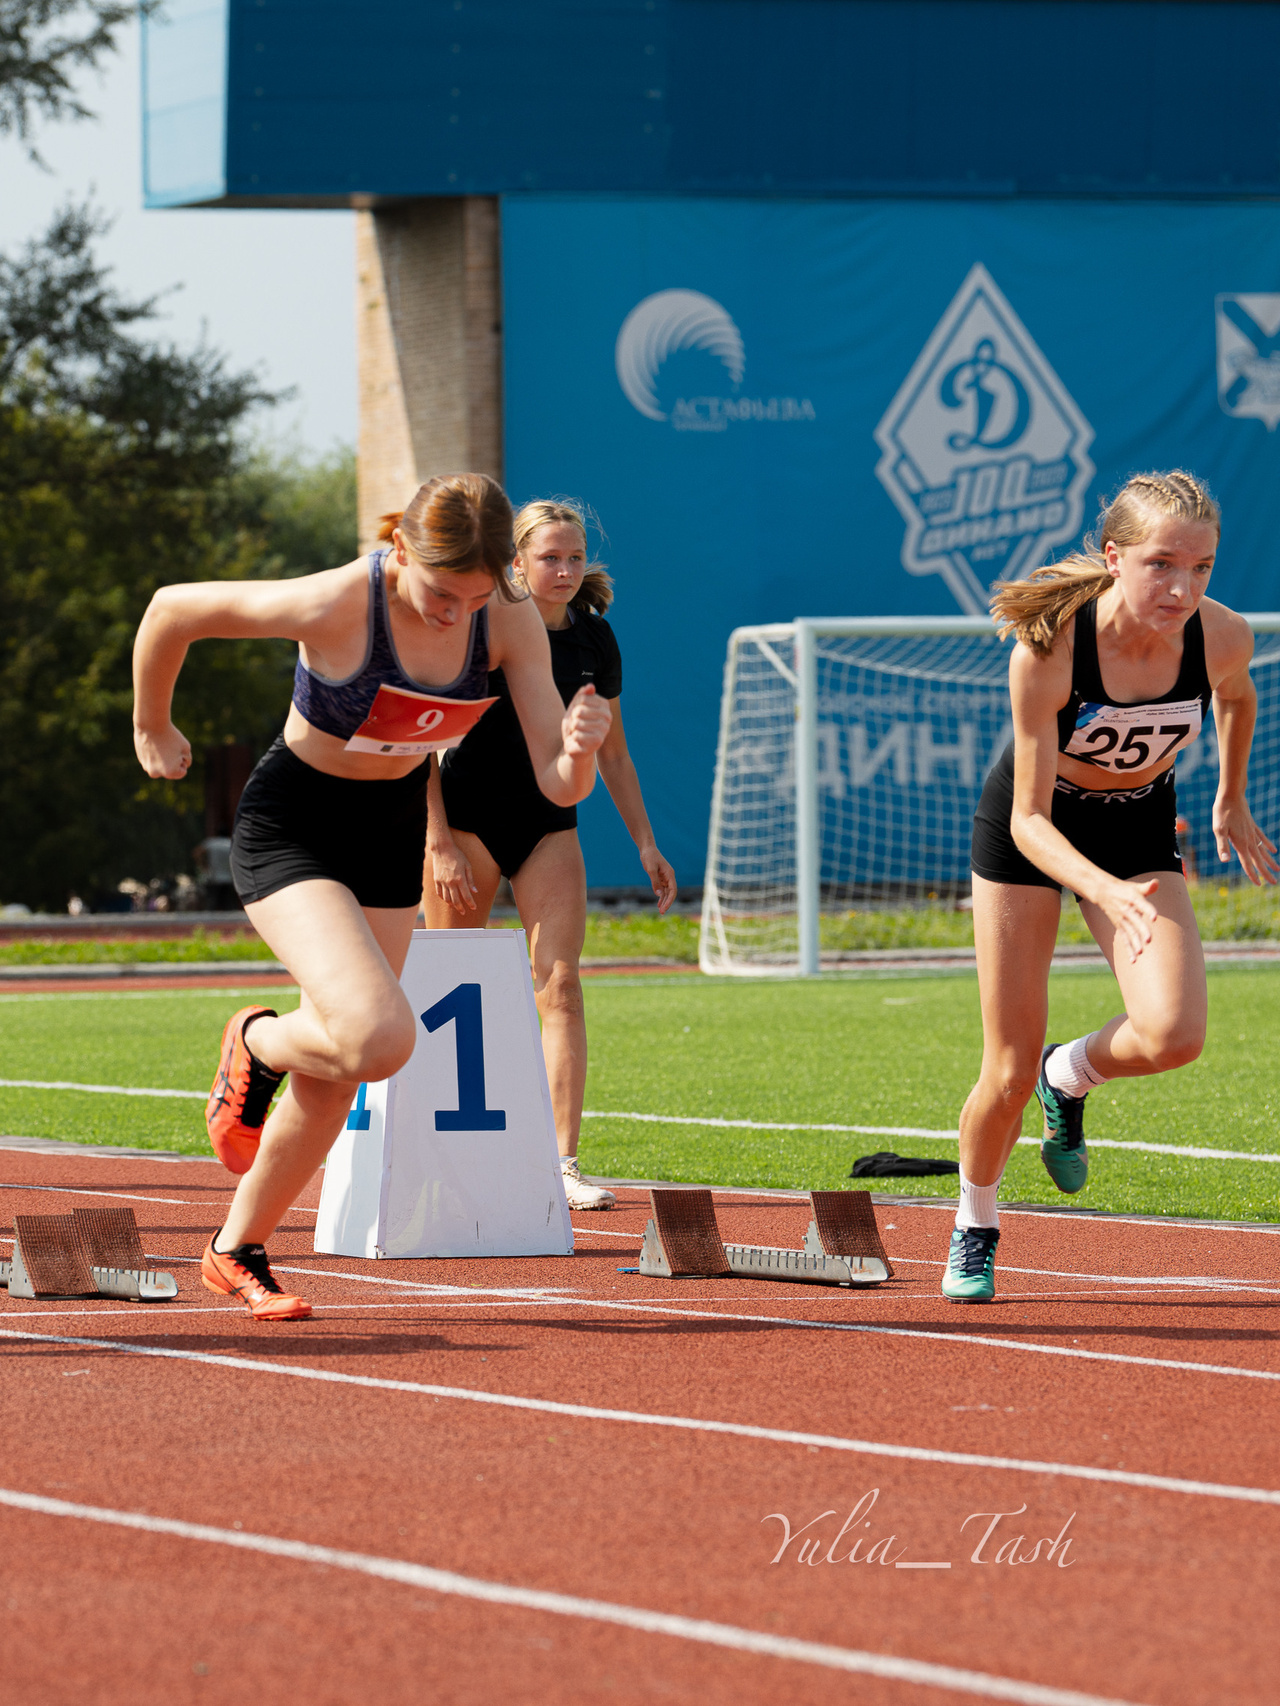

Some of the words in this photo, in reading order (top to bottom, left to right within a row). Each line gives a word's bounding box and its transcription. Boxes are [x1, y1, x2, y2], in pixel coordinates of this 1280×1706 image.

[406, 708, 445, 738] 9
[1078, 723, 1192, 771] 257
[1079, 784, 1155, 803] PRO
[420, 983, 507, 1131] 1
